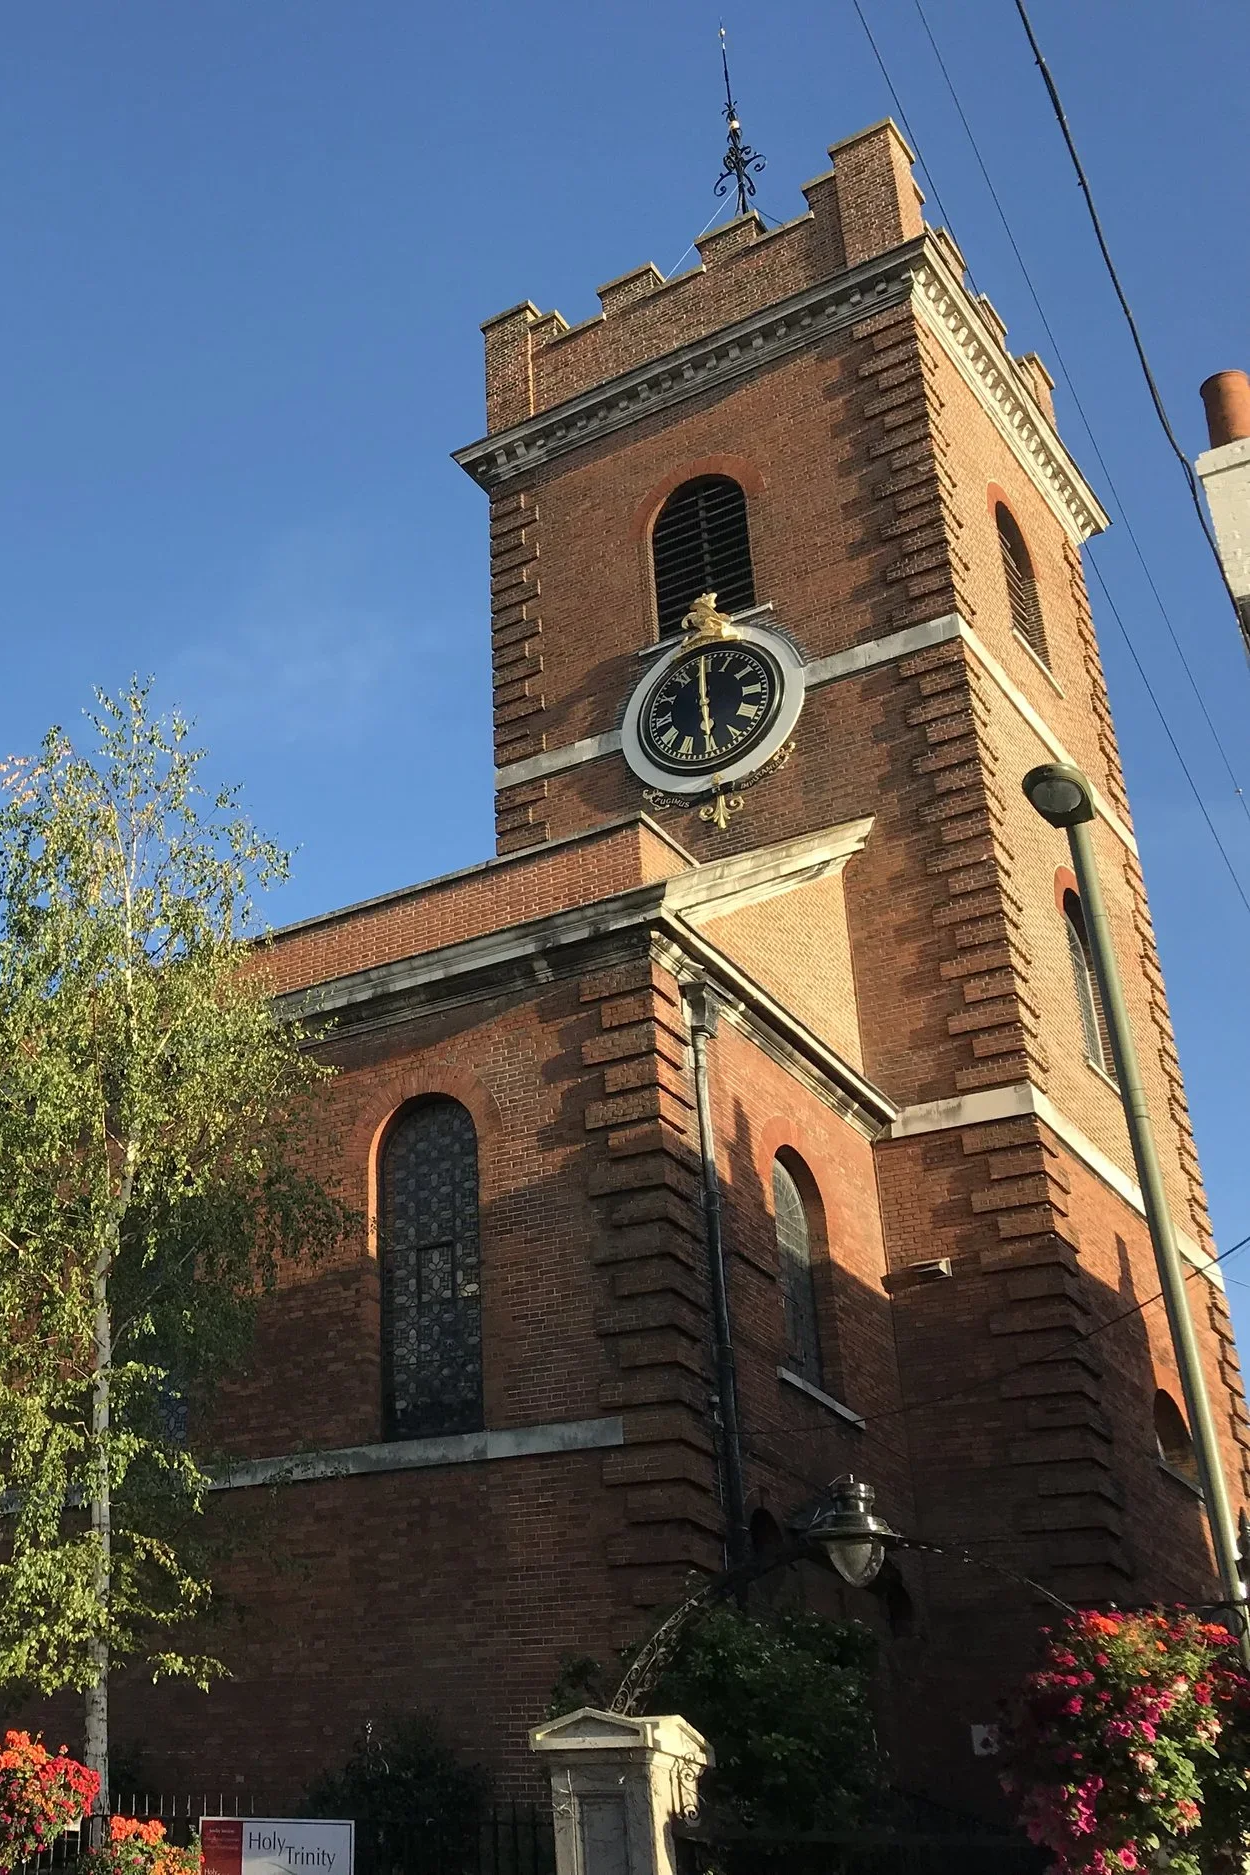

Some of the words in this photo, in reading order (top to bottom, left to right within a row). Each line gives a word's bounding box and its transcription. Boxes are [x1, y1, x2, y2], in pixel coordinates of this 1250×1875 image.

[718, 657, 733, 672] I
[734, 665, 754, 680] II
[742, 682, 762, 697] III
[659, 694, 677, 705] X
[655, 711, 672, 729] IX
[726, 724, 744, 742] V
[249, 1831, 286, 1857] Holy
[285, 1846, 336, 1873] Trinity
